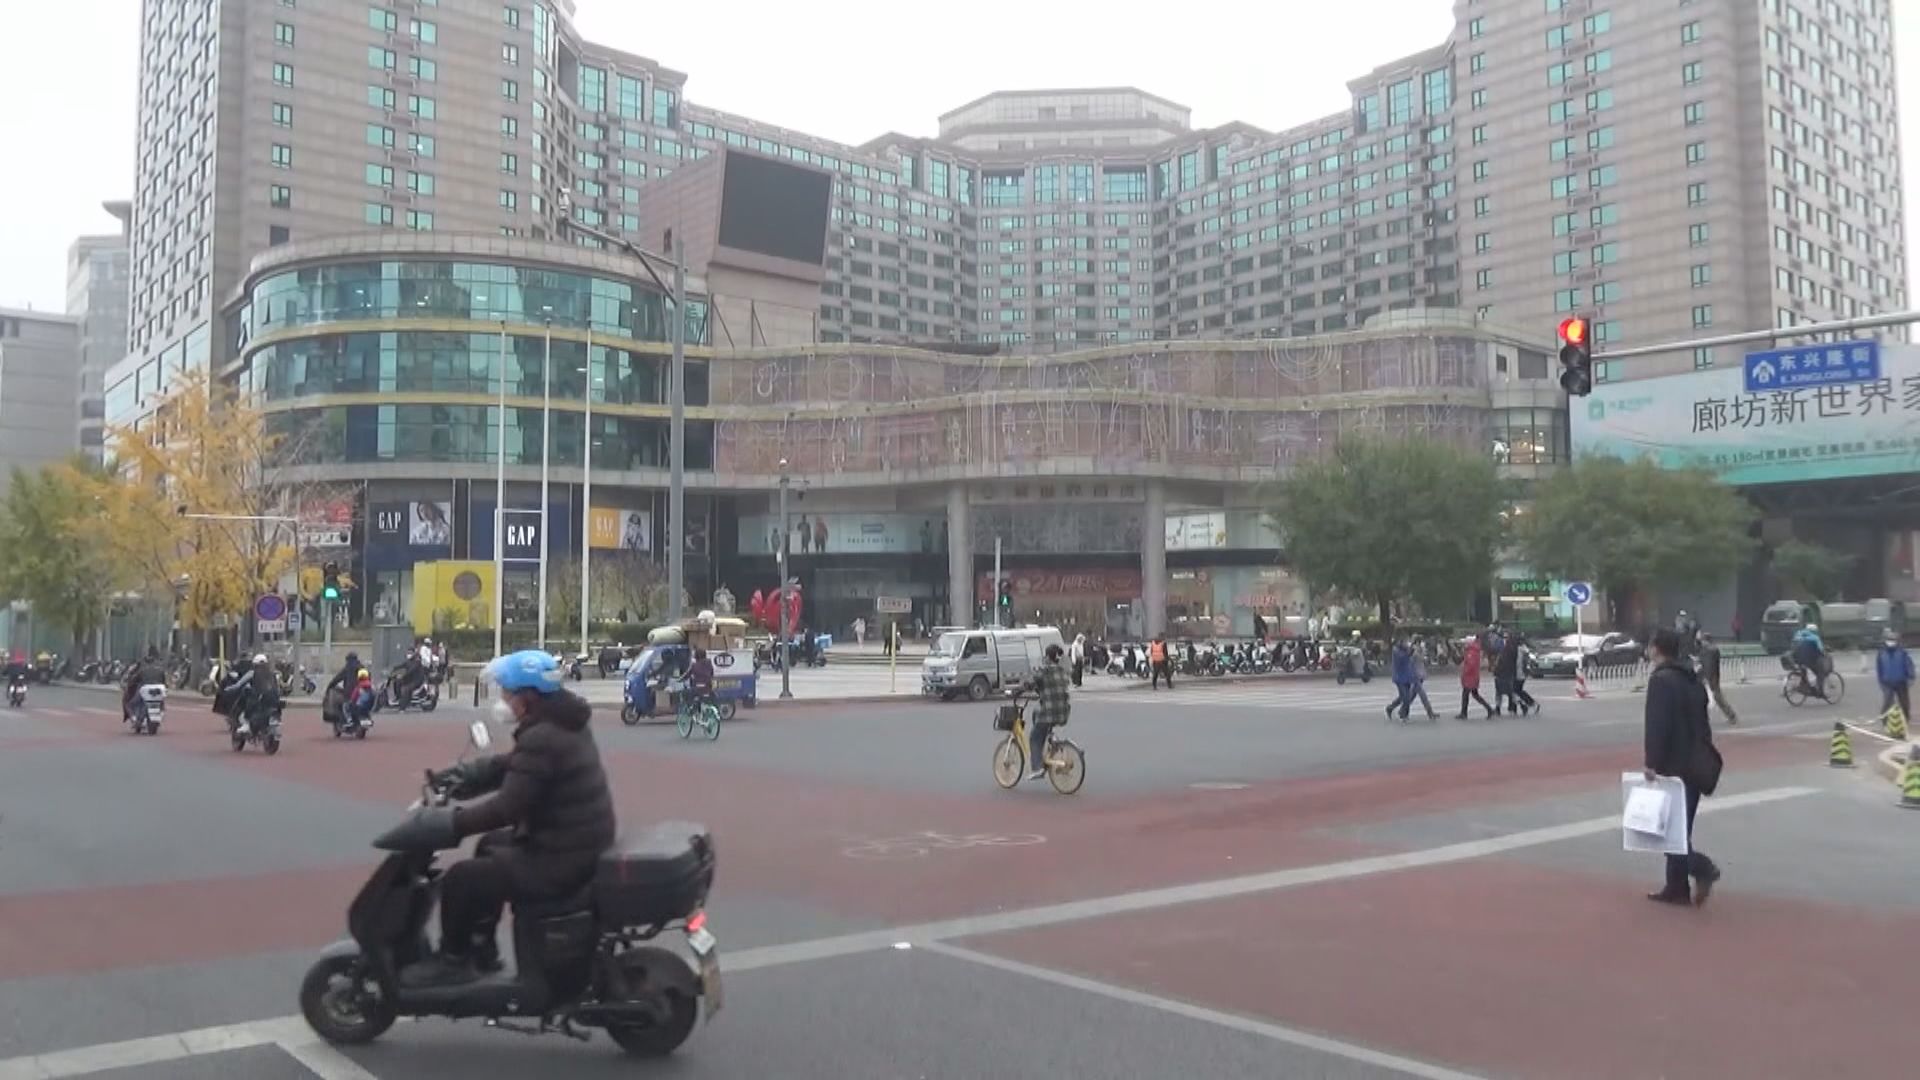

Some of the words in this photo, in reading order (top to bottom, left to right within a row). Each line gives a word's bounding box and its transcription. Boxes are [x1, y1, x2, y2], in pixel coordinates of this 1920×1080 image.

[1779, 347, 1870, 370] 东兴隆街
[378, 512, 401, 529] GAP
[507, 525, 535, 546] GAP
